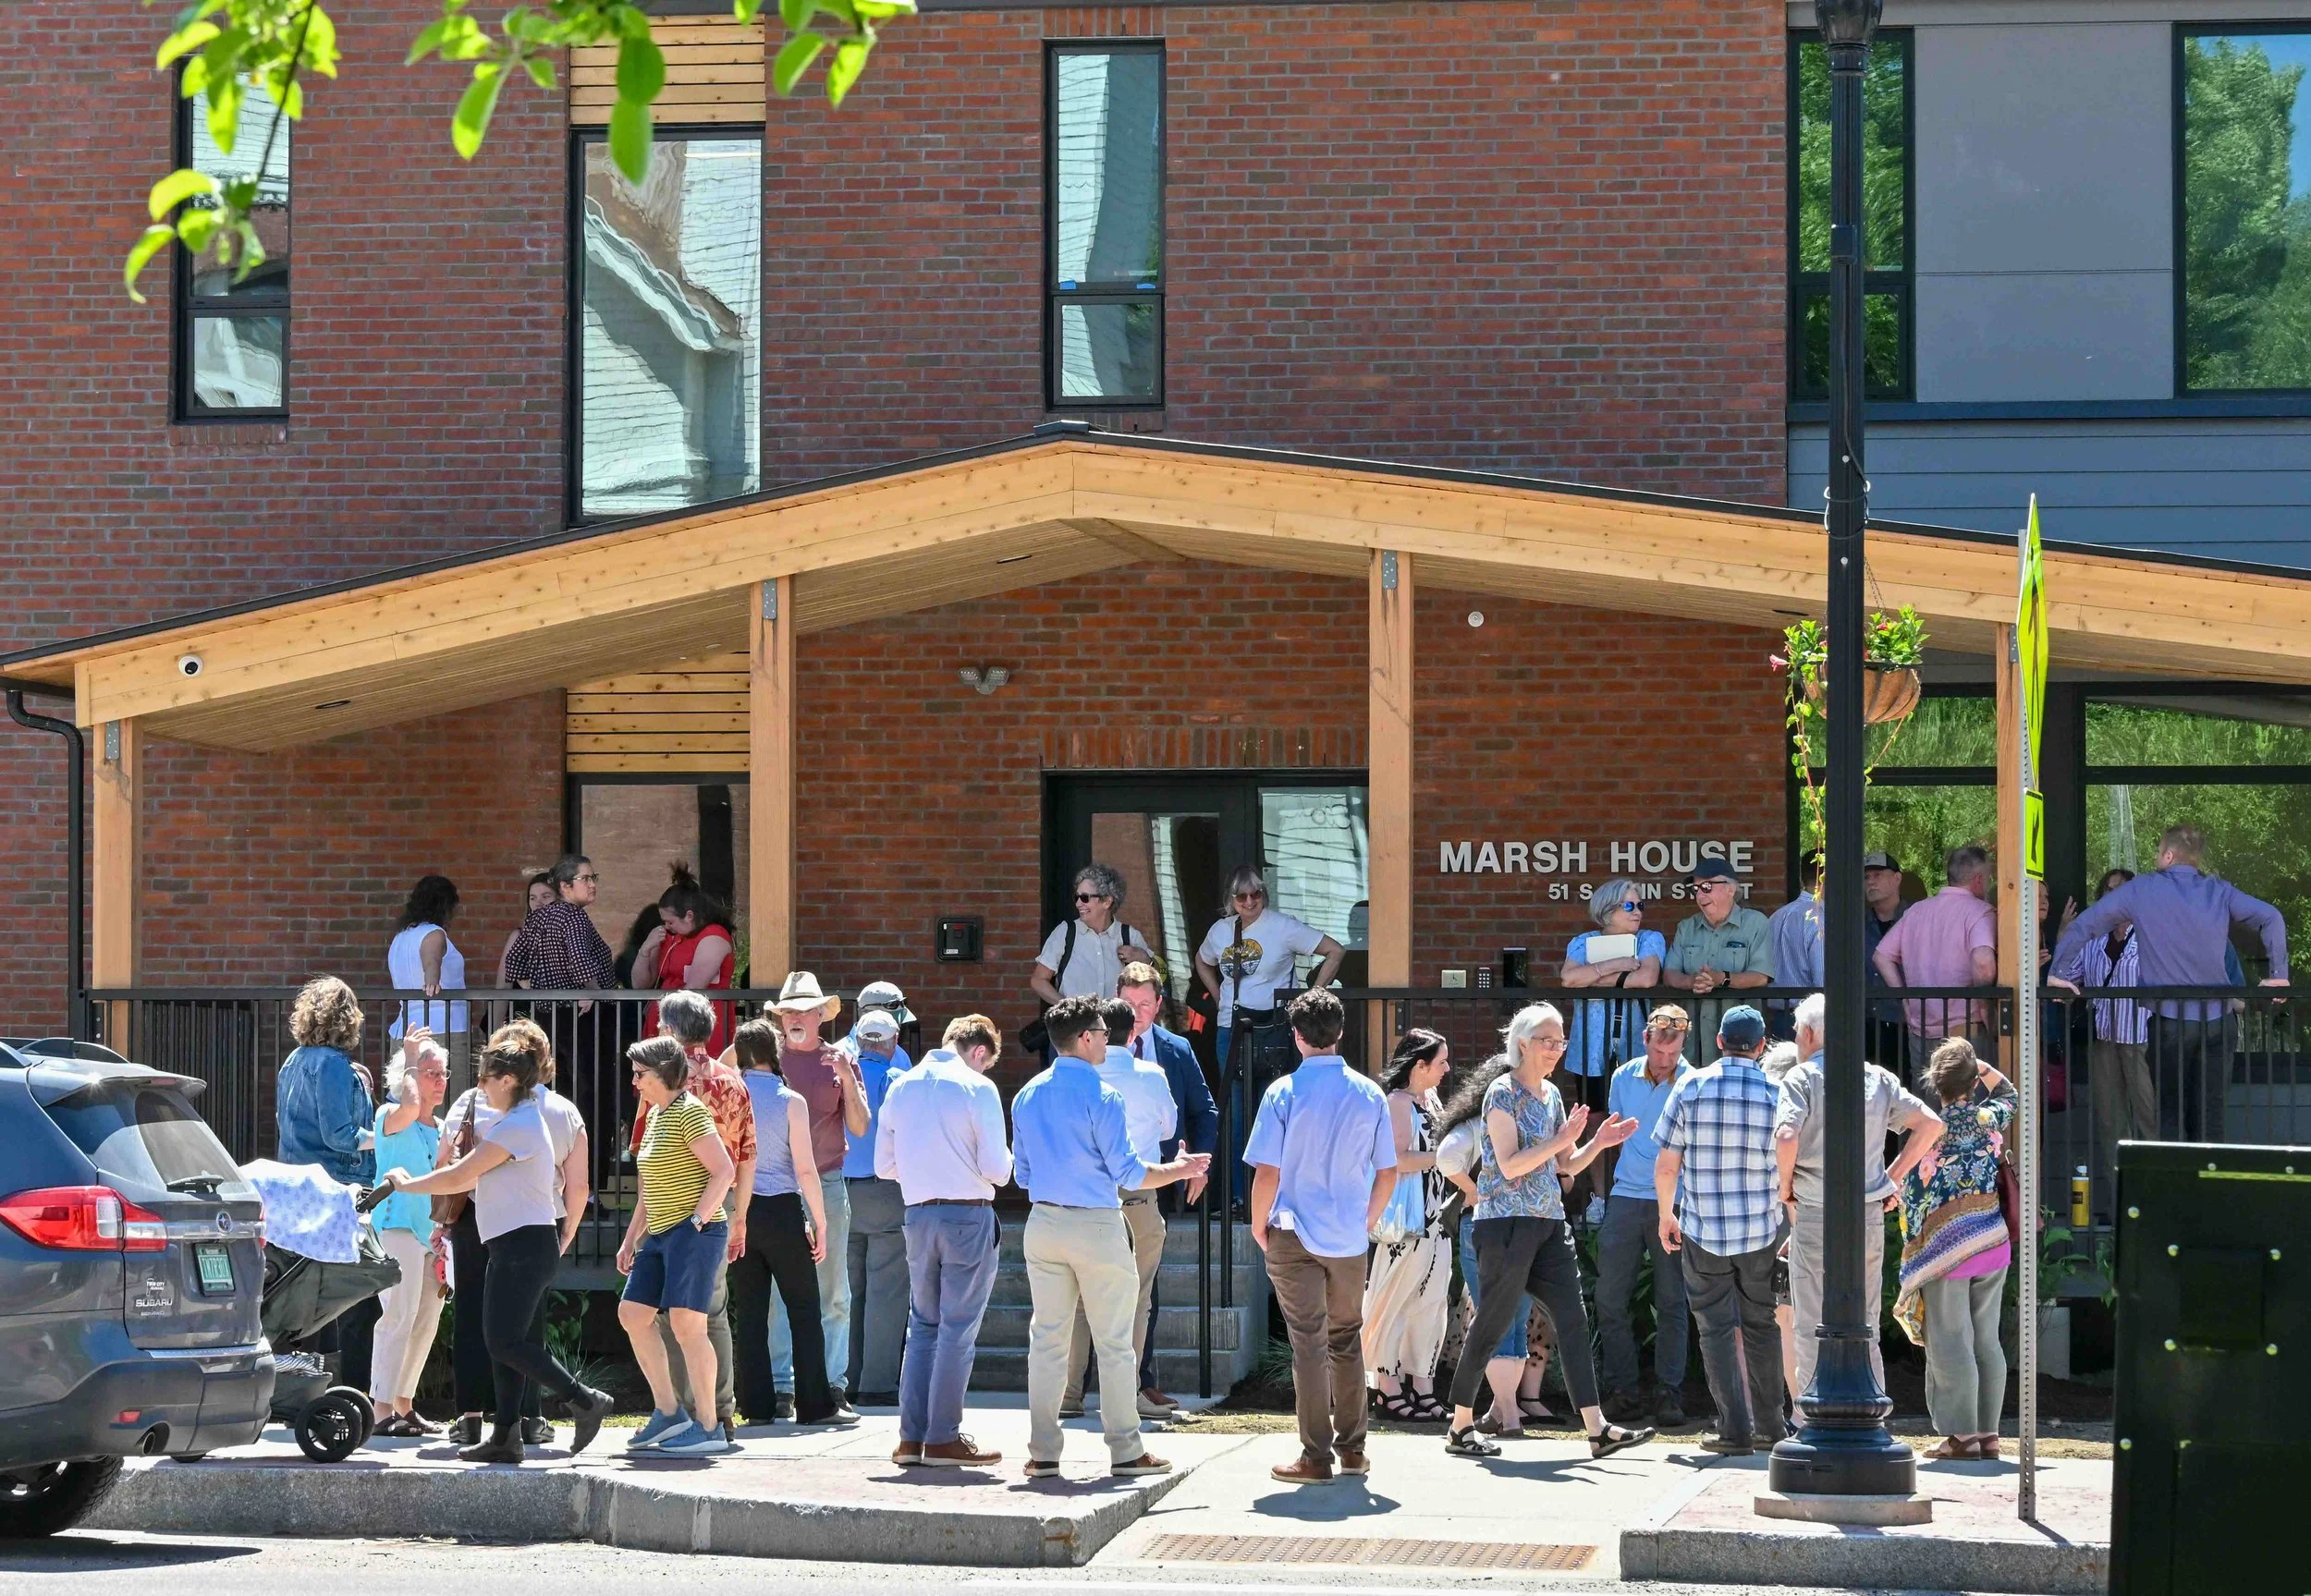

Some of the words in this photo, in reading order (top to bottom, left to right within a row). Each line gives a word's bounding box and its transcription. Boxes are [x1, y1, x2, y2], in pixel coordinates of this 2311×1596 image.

[1440, 841, 1587, 873] MARSH
[1610, 840, 1754, 873] HOUSE
[1548, 883, 1569, 900] 51
[135, 1298, 173, 1308] SUBARU
